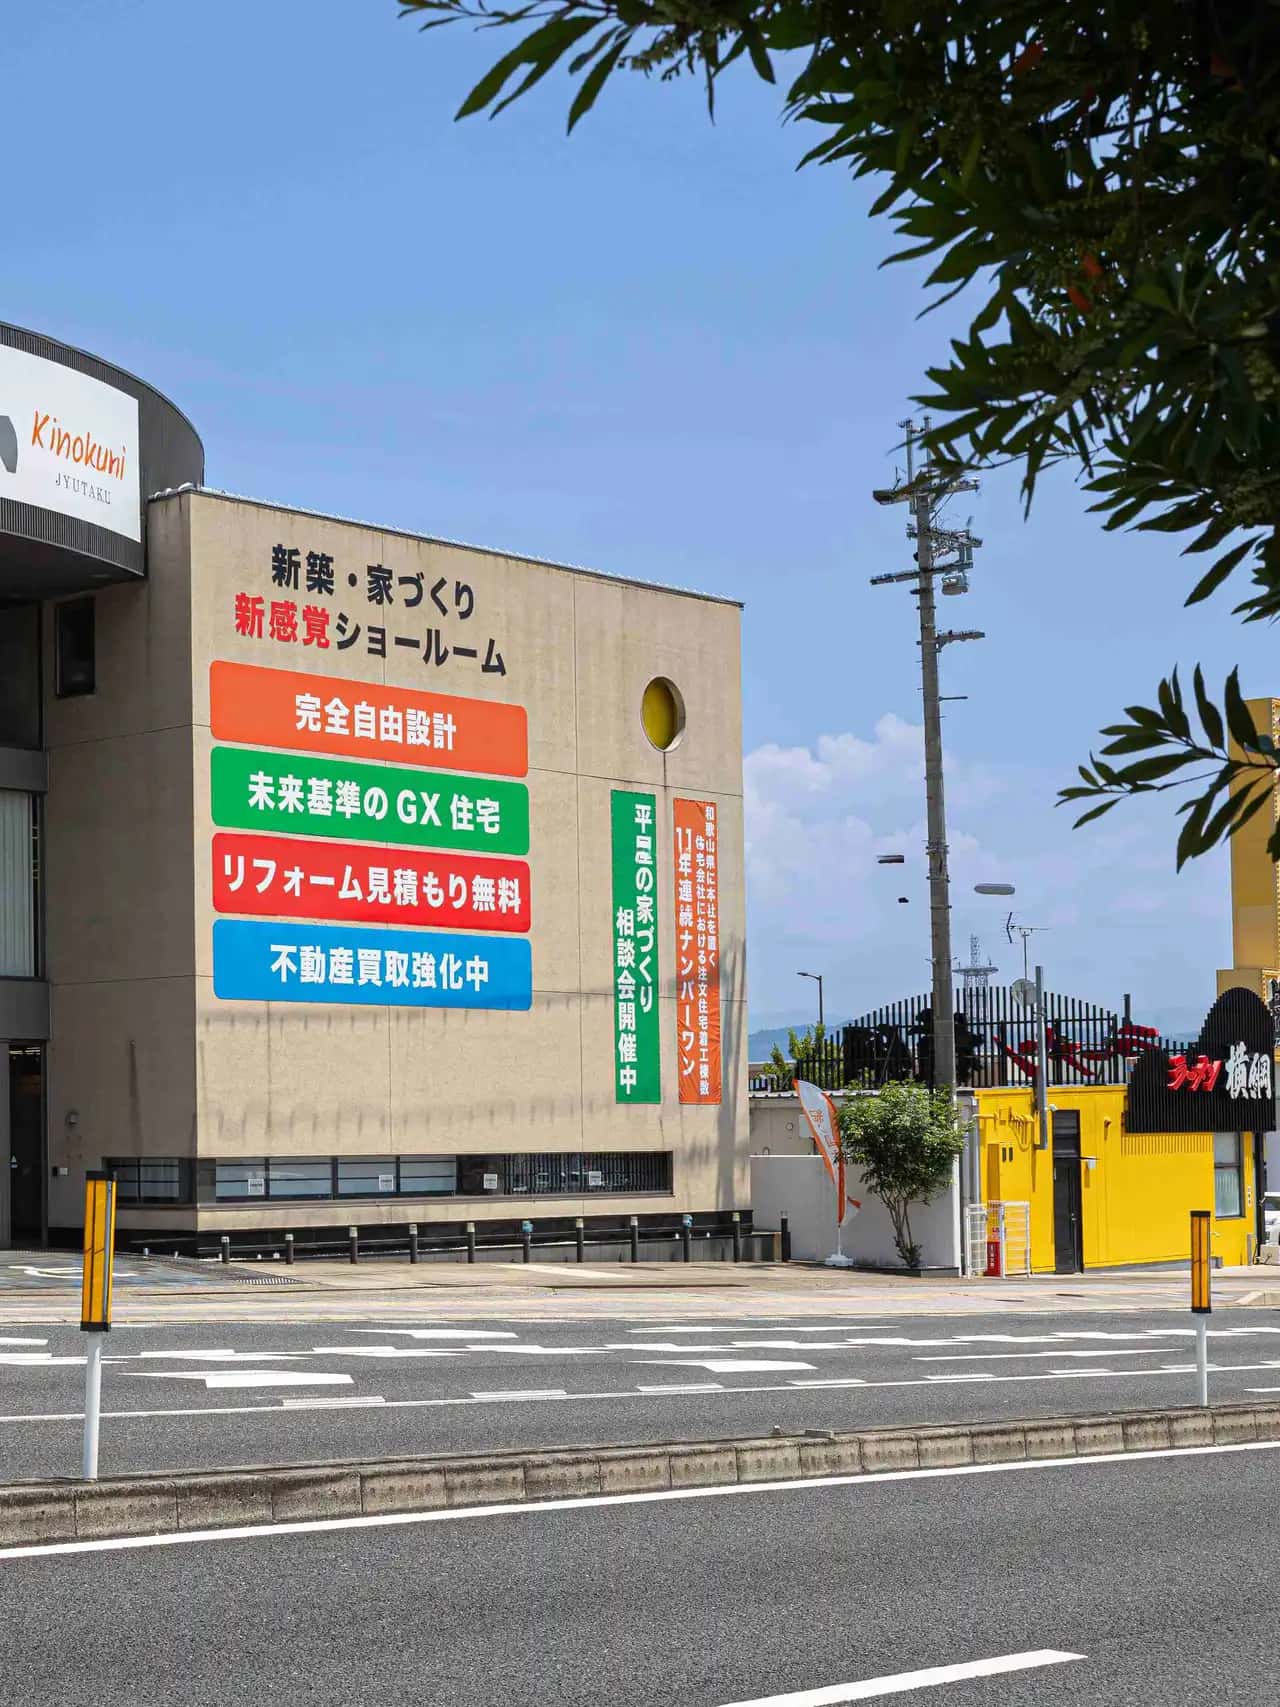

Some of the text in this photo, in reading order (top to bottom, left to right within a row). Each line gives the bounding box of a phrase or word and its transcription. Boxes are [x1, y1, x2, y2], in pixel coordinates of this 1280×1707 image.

[31, 410, 127, 481] Kinokuni
[55, 472, 112, 505] JYUTAKU
[271, 544, 475, 619] 新築・家づくり
[235, 592, 507, 676] 新感覚ショールーム
[295, 693, 457, 750] 完全自由設計
[248, 770, 501, 834] 未来基準の GX 住宅
[223, 855, 521, 914] リフォーム見積もり無料
[270, 944, 490, 992] 不動産買取強化中
[616, 906, 637, 1095] 相談会開催中
